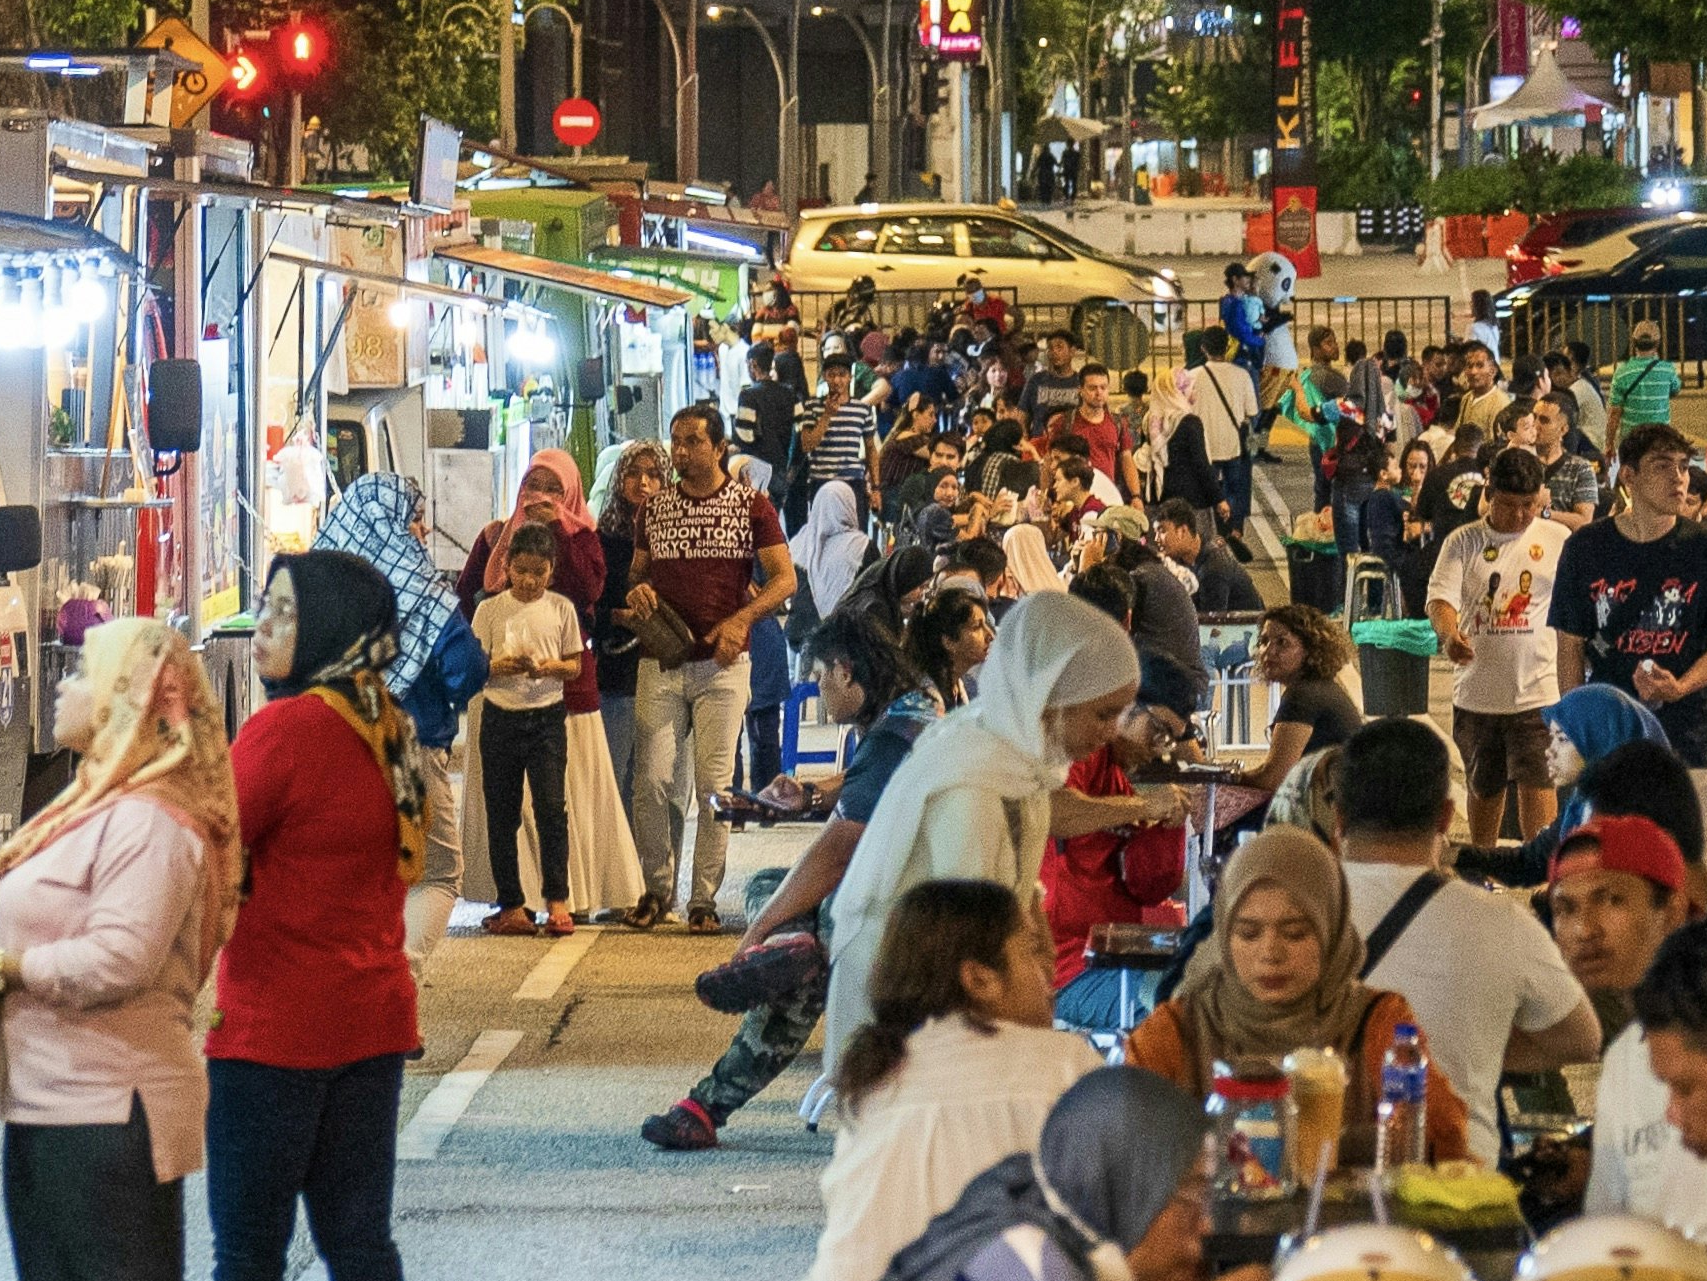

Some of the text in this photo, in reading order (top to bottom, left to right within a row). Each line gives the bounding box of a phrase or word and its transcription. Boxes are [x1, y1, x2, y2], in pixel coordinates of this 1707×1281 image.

[687, 506, 750, 517] BROOKLYN
[675, 517, 715, 527] LONDON
[684, 548, 744, 559] BROOKLYN
